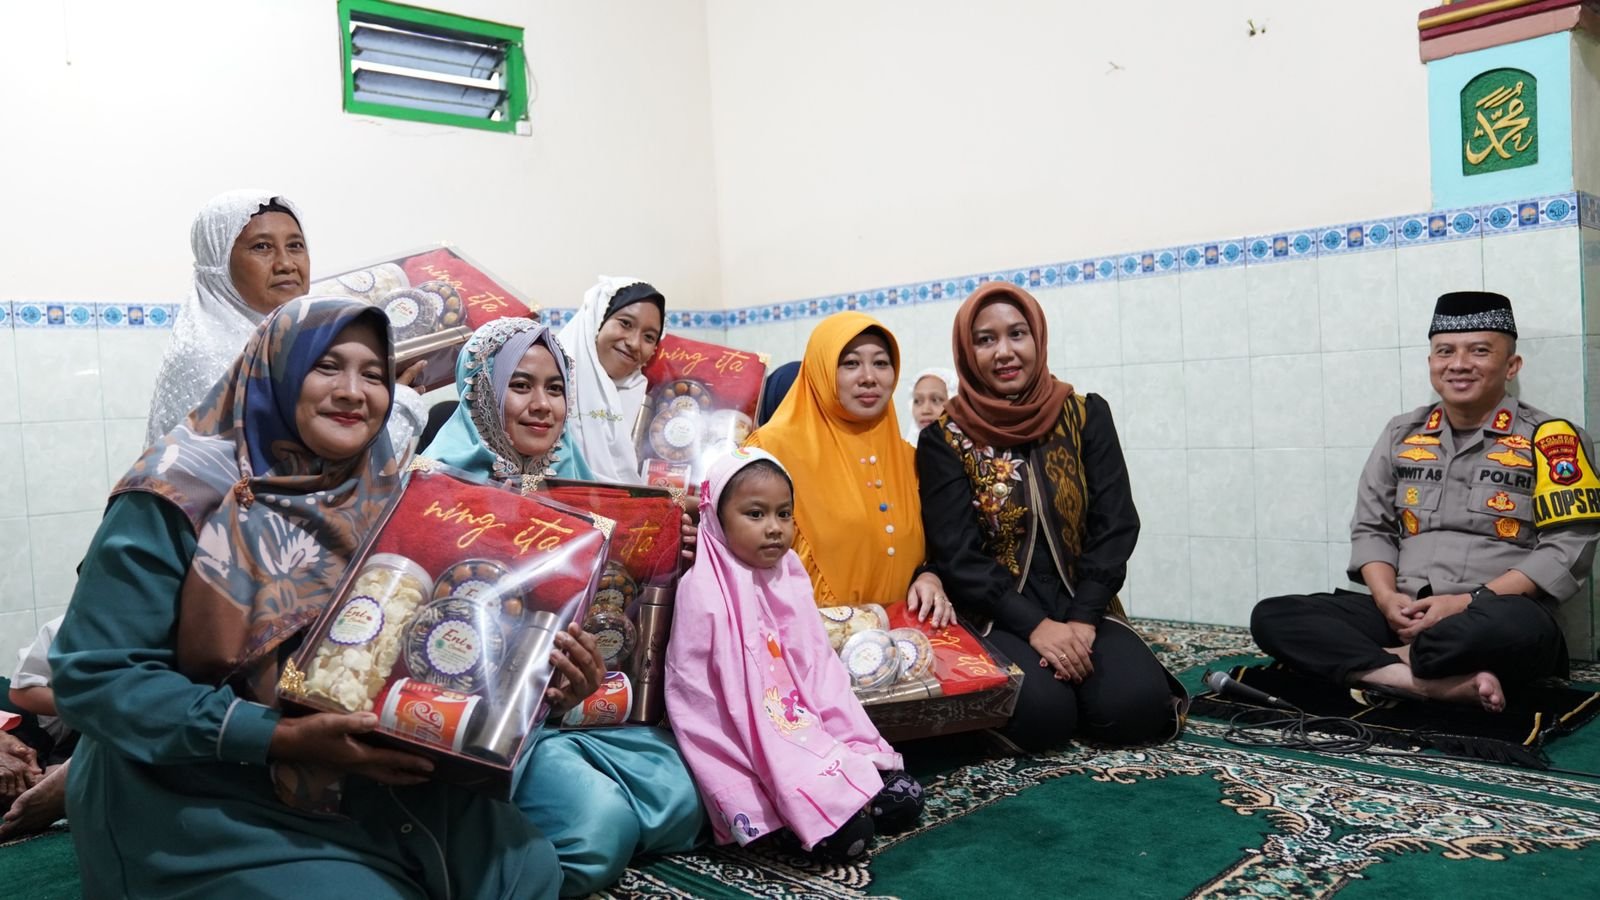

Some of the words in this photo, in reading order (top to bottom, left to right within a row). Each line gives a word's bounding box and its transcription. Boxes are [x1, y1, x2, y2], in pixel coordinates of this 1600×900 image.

[658, 347, 710, 376] ning
[714, 350, 750, 375] ita
[1479, 469, 1532, 489] POLRI
[423, 500, 506, 549] ning
[513, 517, 573, 554] ita
[620, 519, 661, 561] ita
[441, 628, 468, 646] Eni
